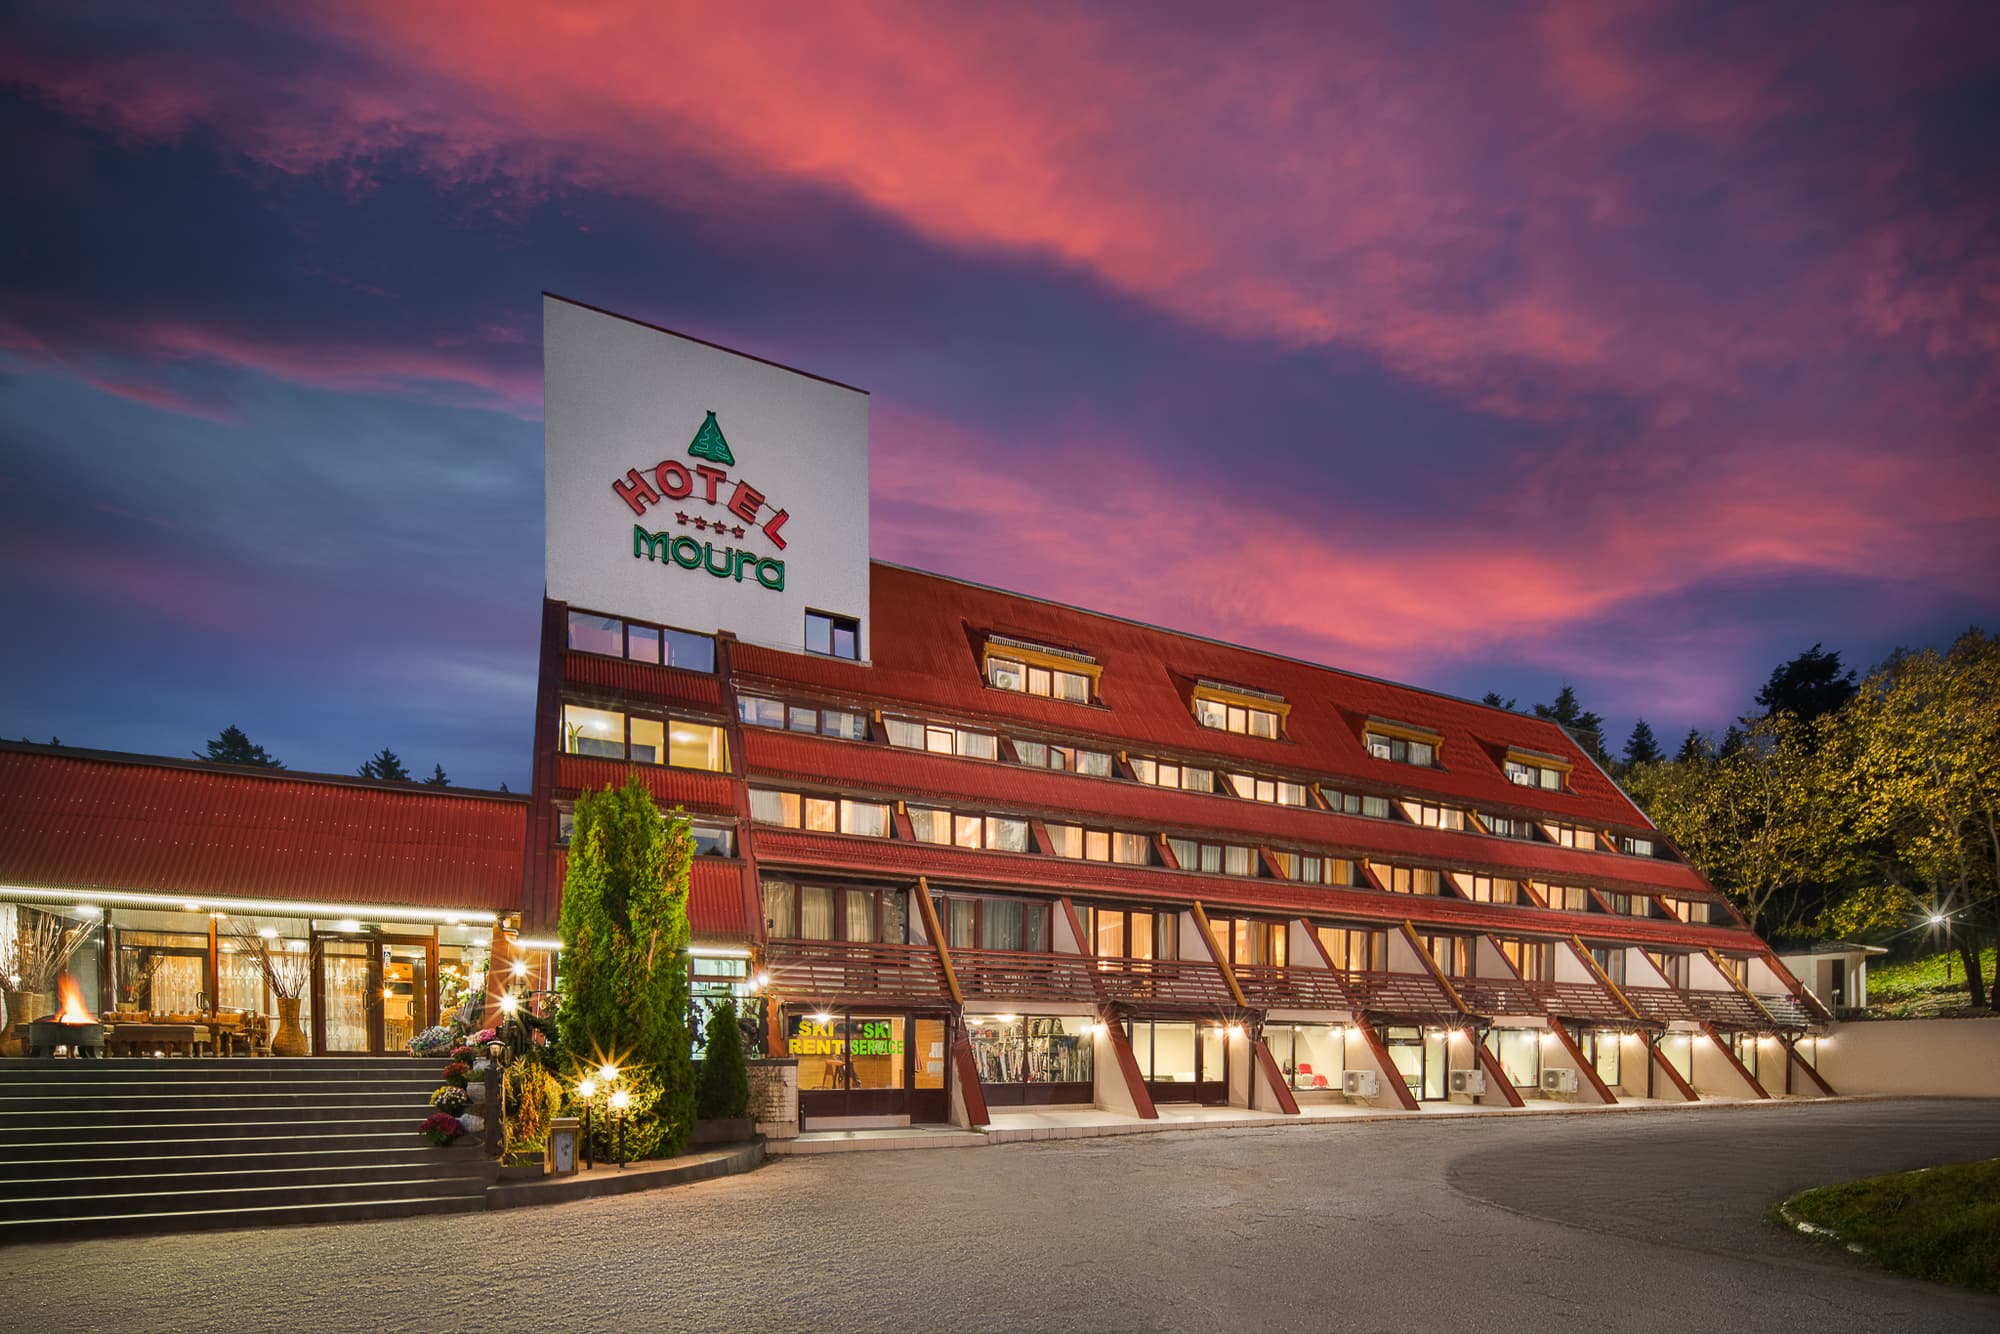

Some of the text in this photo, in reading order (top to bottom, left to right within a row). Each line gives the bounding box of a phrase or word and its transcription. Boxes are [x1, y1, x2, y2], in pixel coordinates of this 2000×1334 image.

[612, 460, 789, 550] HOTEL
[799, 1020, 834, 1037] SKI
[863, 1023, 892, 1039] SKI
[788, 1039, 843, 1055] RENT
[851, 1039, 904, 1056] SERVICE
